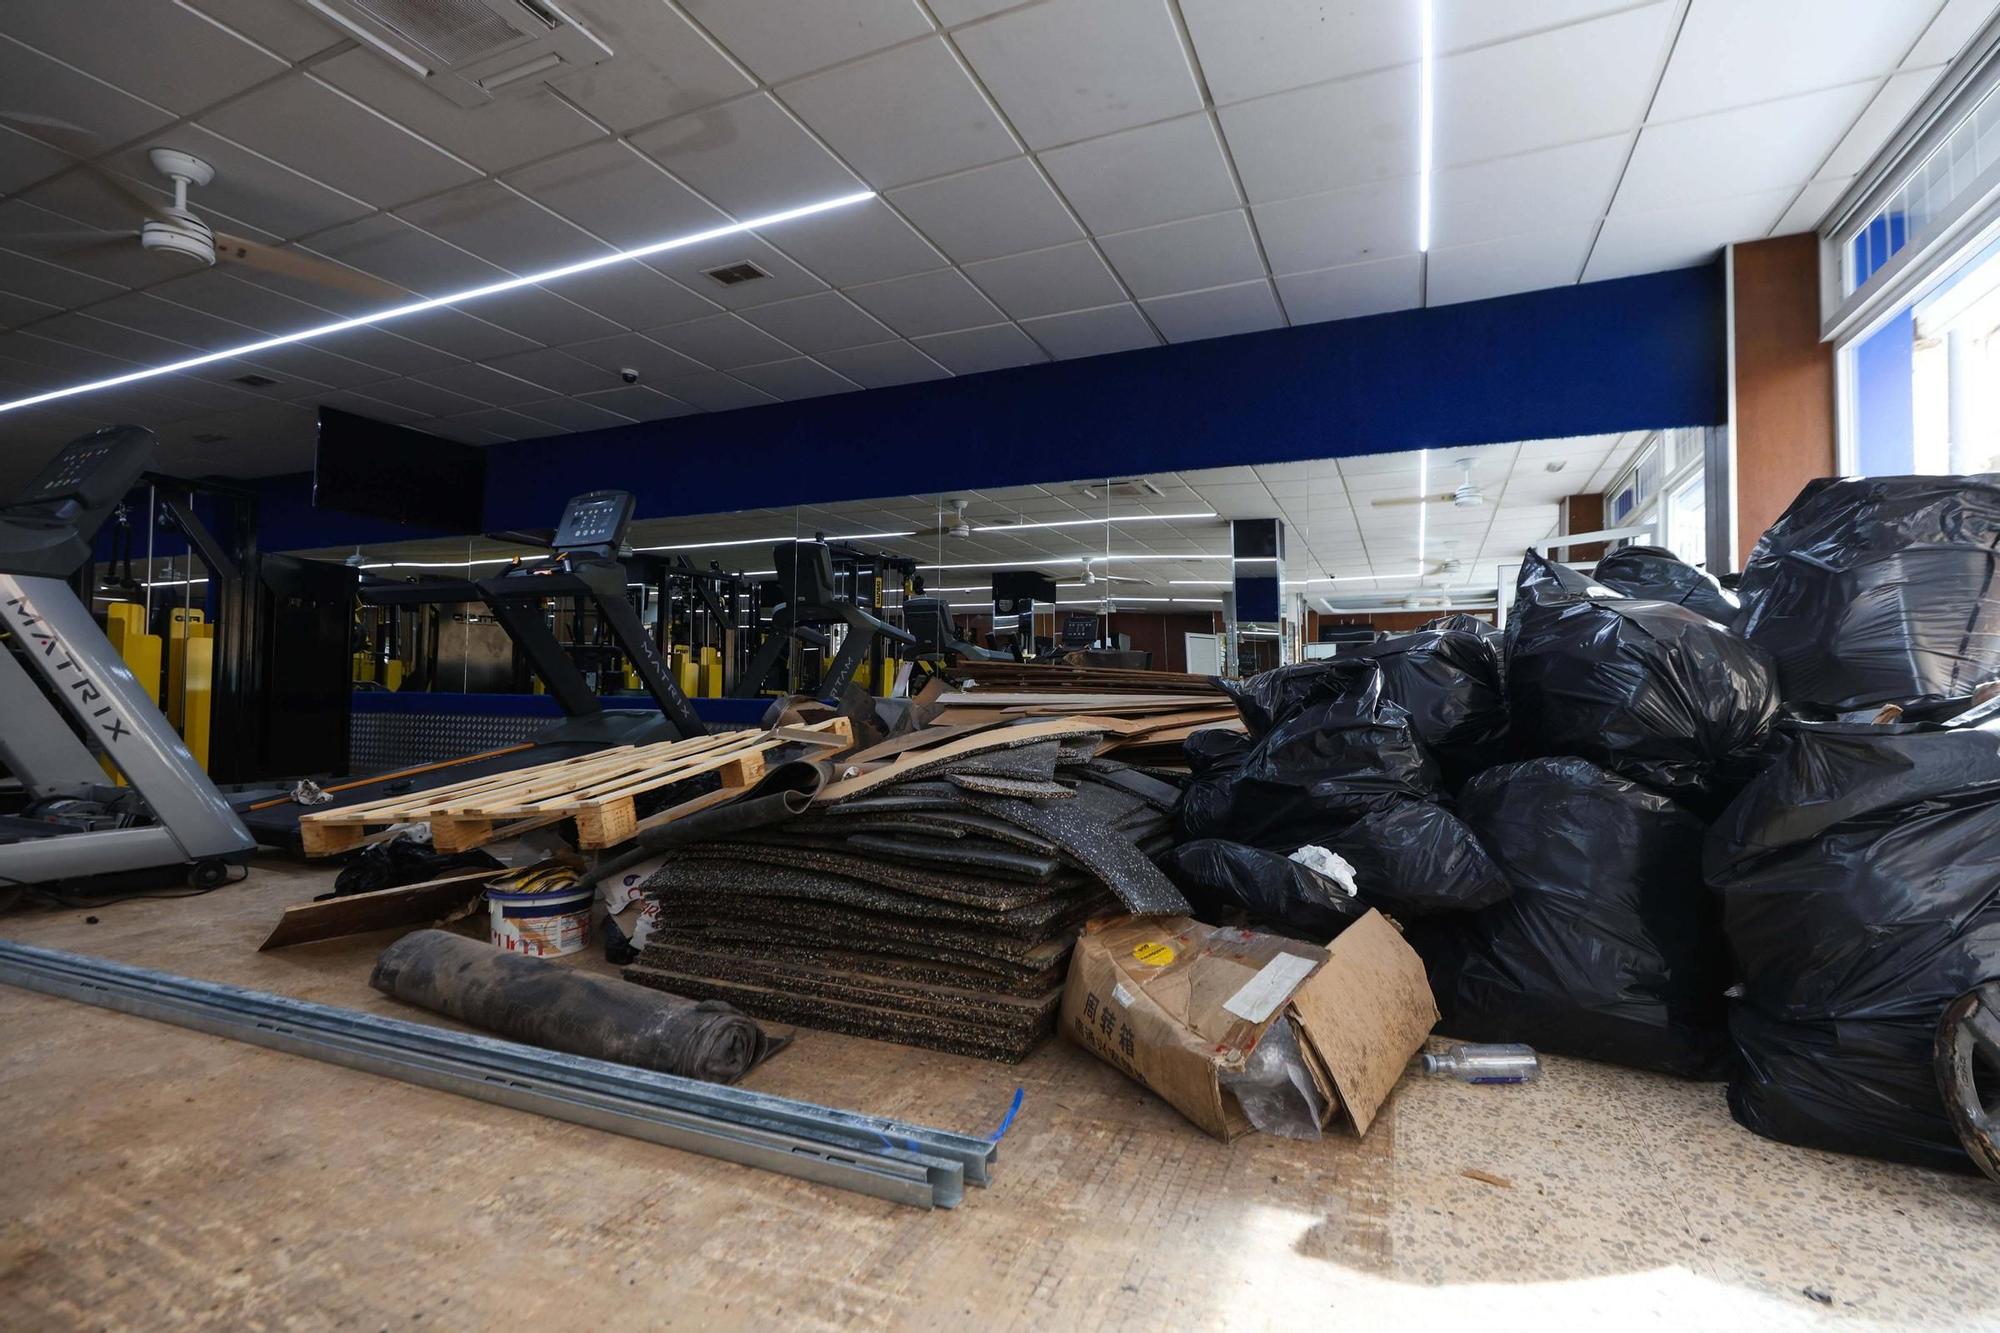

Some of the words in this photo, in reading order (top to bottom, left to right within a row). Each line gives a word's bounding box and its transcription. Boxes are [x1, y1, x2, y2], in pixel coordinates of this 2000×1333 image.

[7, 594, 131, 742] MATRIX
[641, 641, 690, 719] MATRIX
[1083, 992, 1135, 1058] 周转箱
